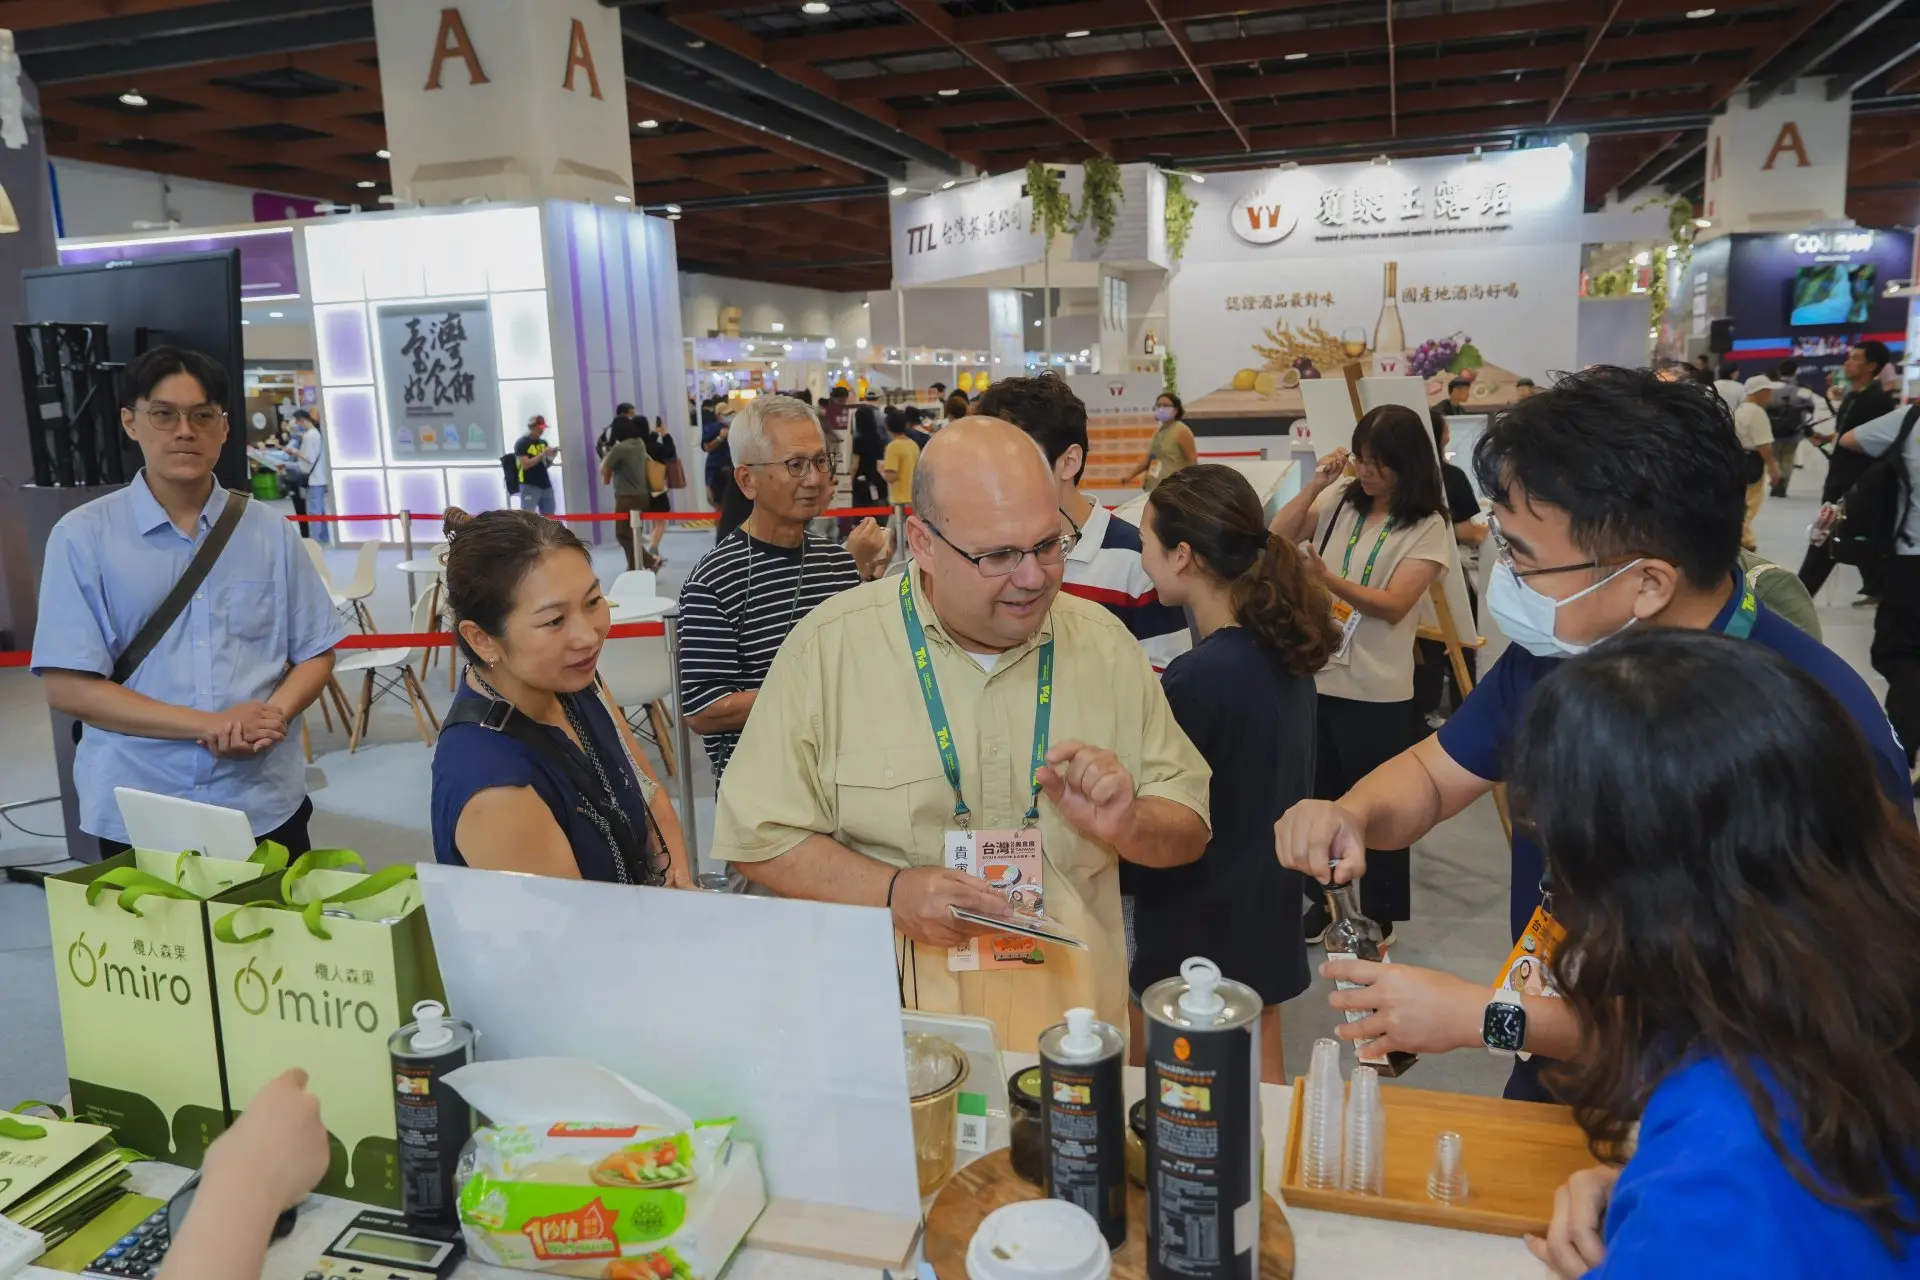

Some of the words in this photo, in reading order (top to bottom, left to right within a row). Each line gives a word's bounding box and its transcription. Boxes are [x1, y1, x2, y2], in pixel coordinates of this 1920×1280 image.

[425, 8, 489, 91] A
[563, 19, 604, 101] A
[1760, 121, 1812, 171] A
[907, 223, 937, 255] TTL
[1225, 290, 1336, 311] 認證酒品最對味
[1402, 282, 1519, 304] 國產地酒尚好喝
[982, 841, 1009, 855] 台灣
